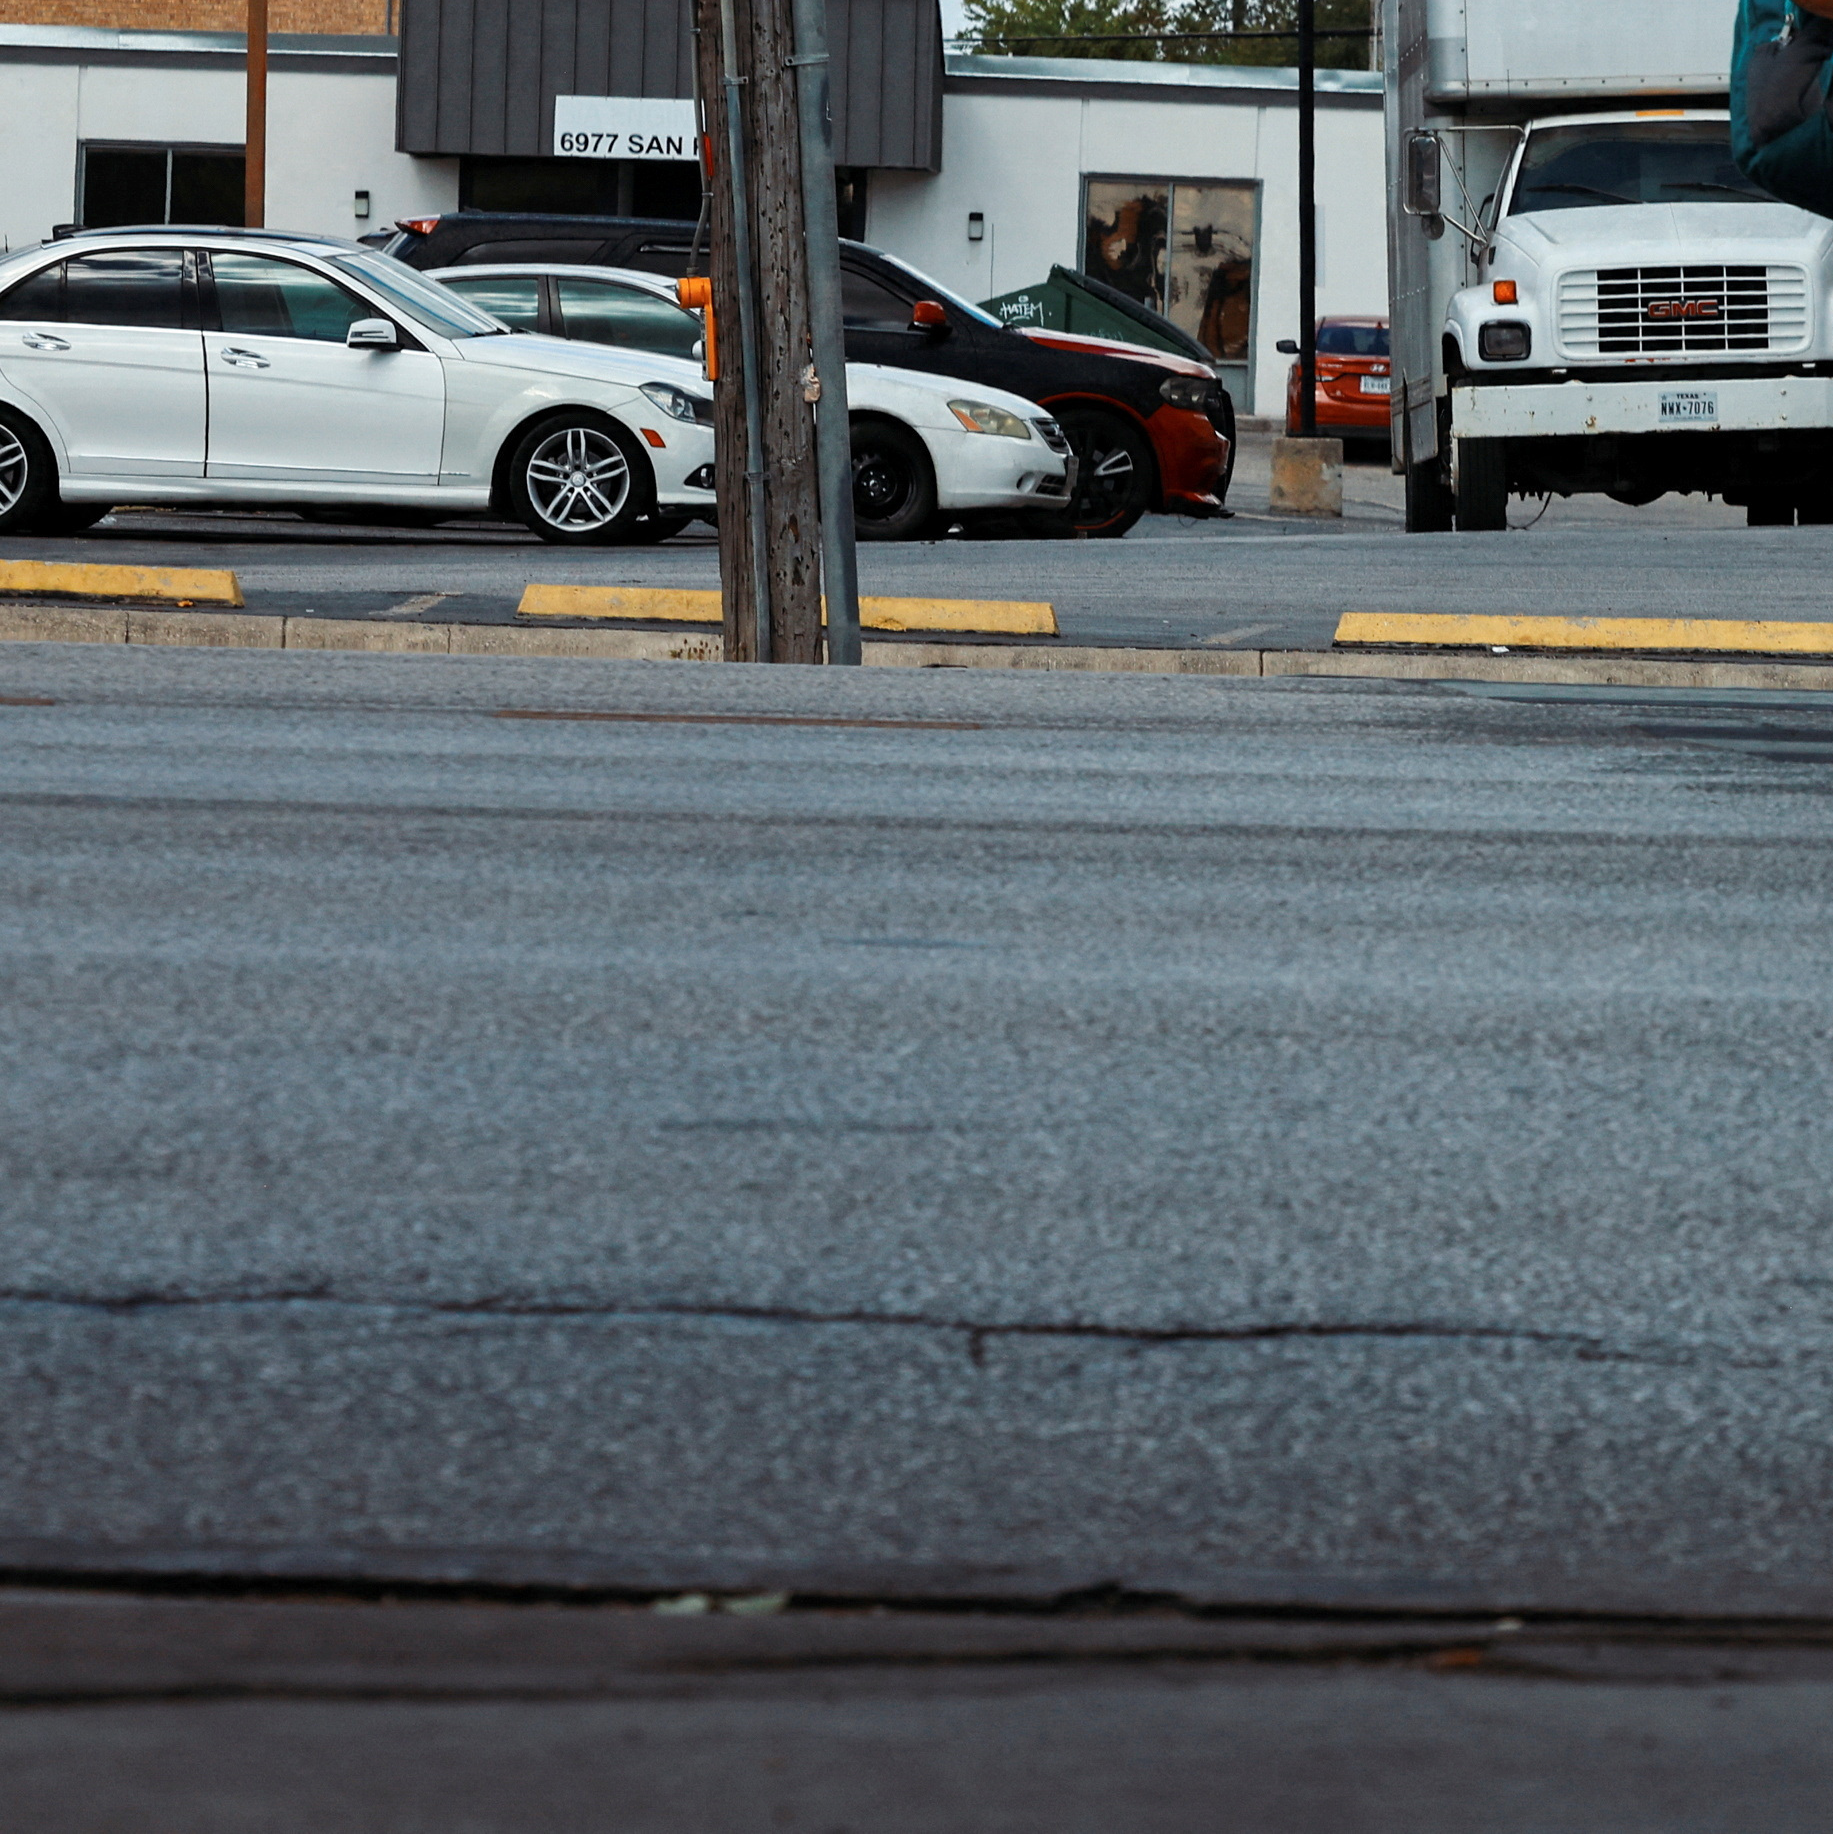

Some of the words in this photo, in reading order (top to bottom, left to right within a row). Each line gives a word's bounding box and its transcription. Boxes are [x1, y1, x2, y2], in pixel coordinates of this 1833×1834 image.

[560, 132, 619, 153] 6977
[628, 134, 683, 155] SAN
[1648, 299, 1718, 318] GMC
